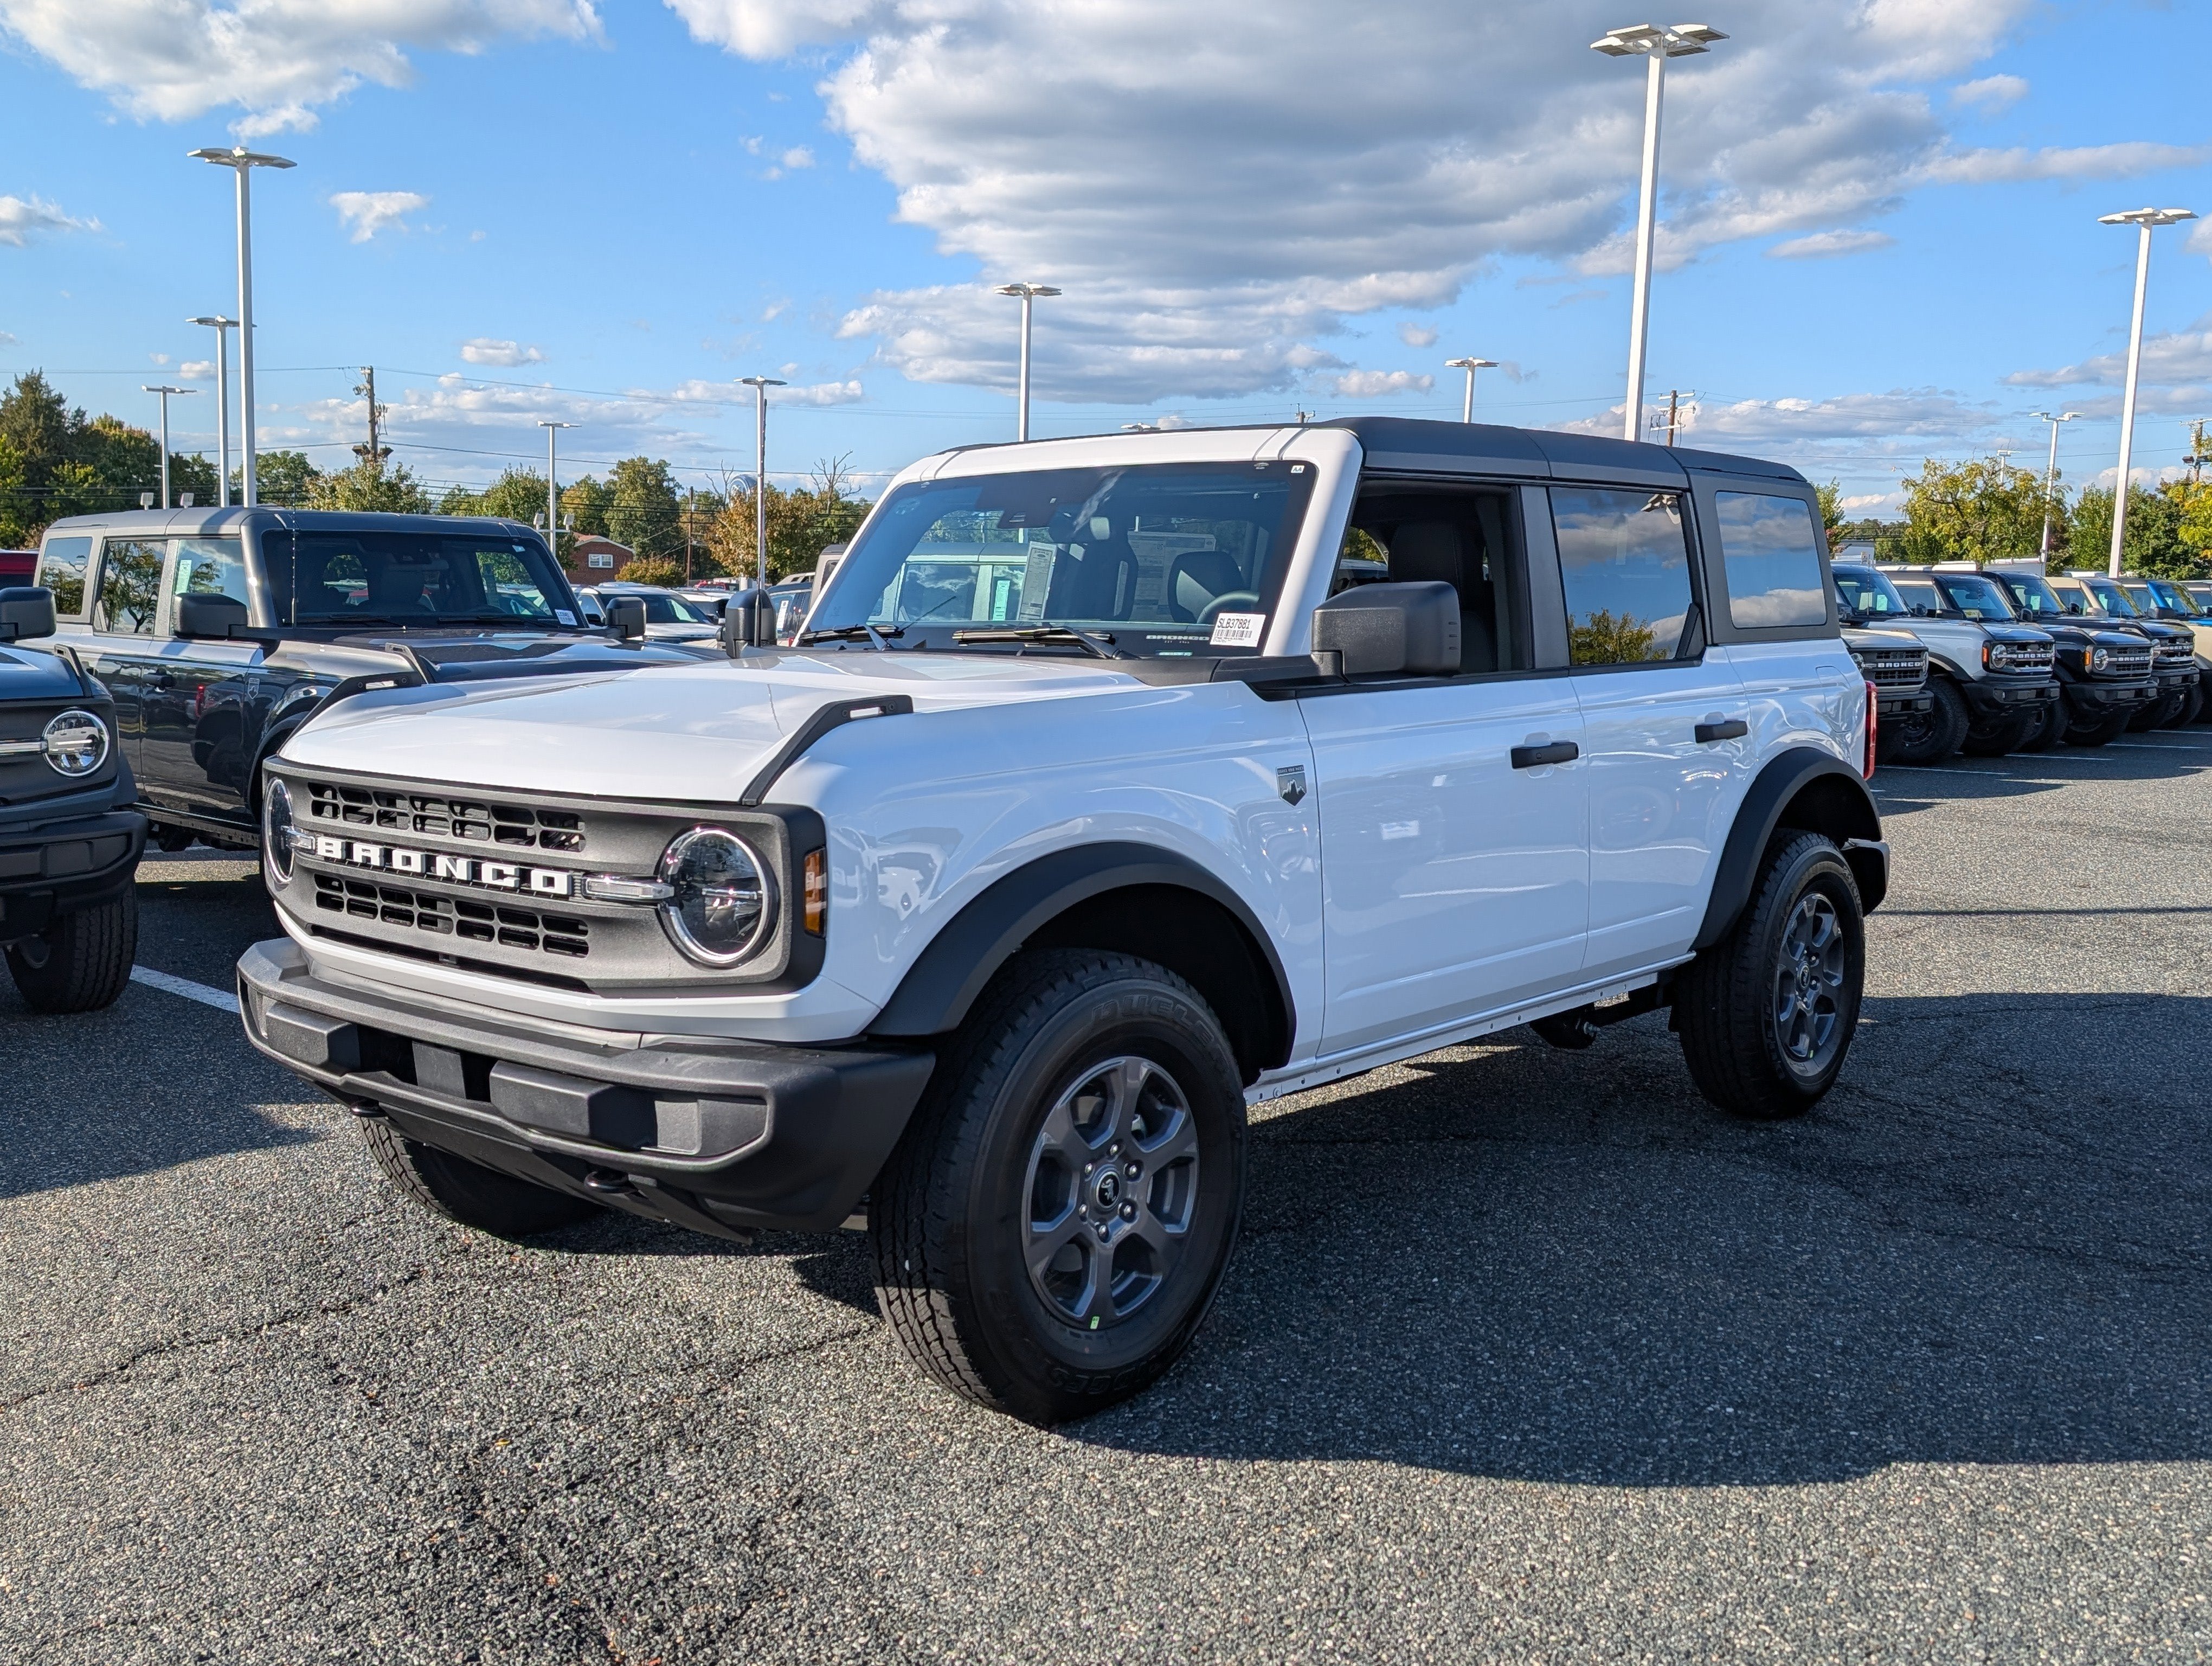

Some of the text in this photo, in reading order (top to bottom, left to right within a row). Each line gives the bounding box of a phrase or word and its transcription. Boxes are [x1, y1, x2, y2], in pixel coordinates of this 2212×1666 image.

[1217, 618, 1251, 629] SLB37881
[317, 836, 573, 895] BRONCO
[1091, 994, 1227, 1068] DUELE
